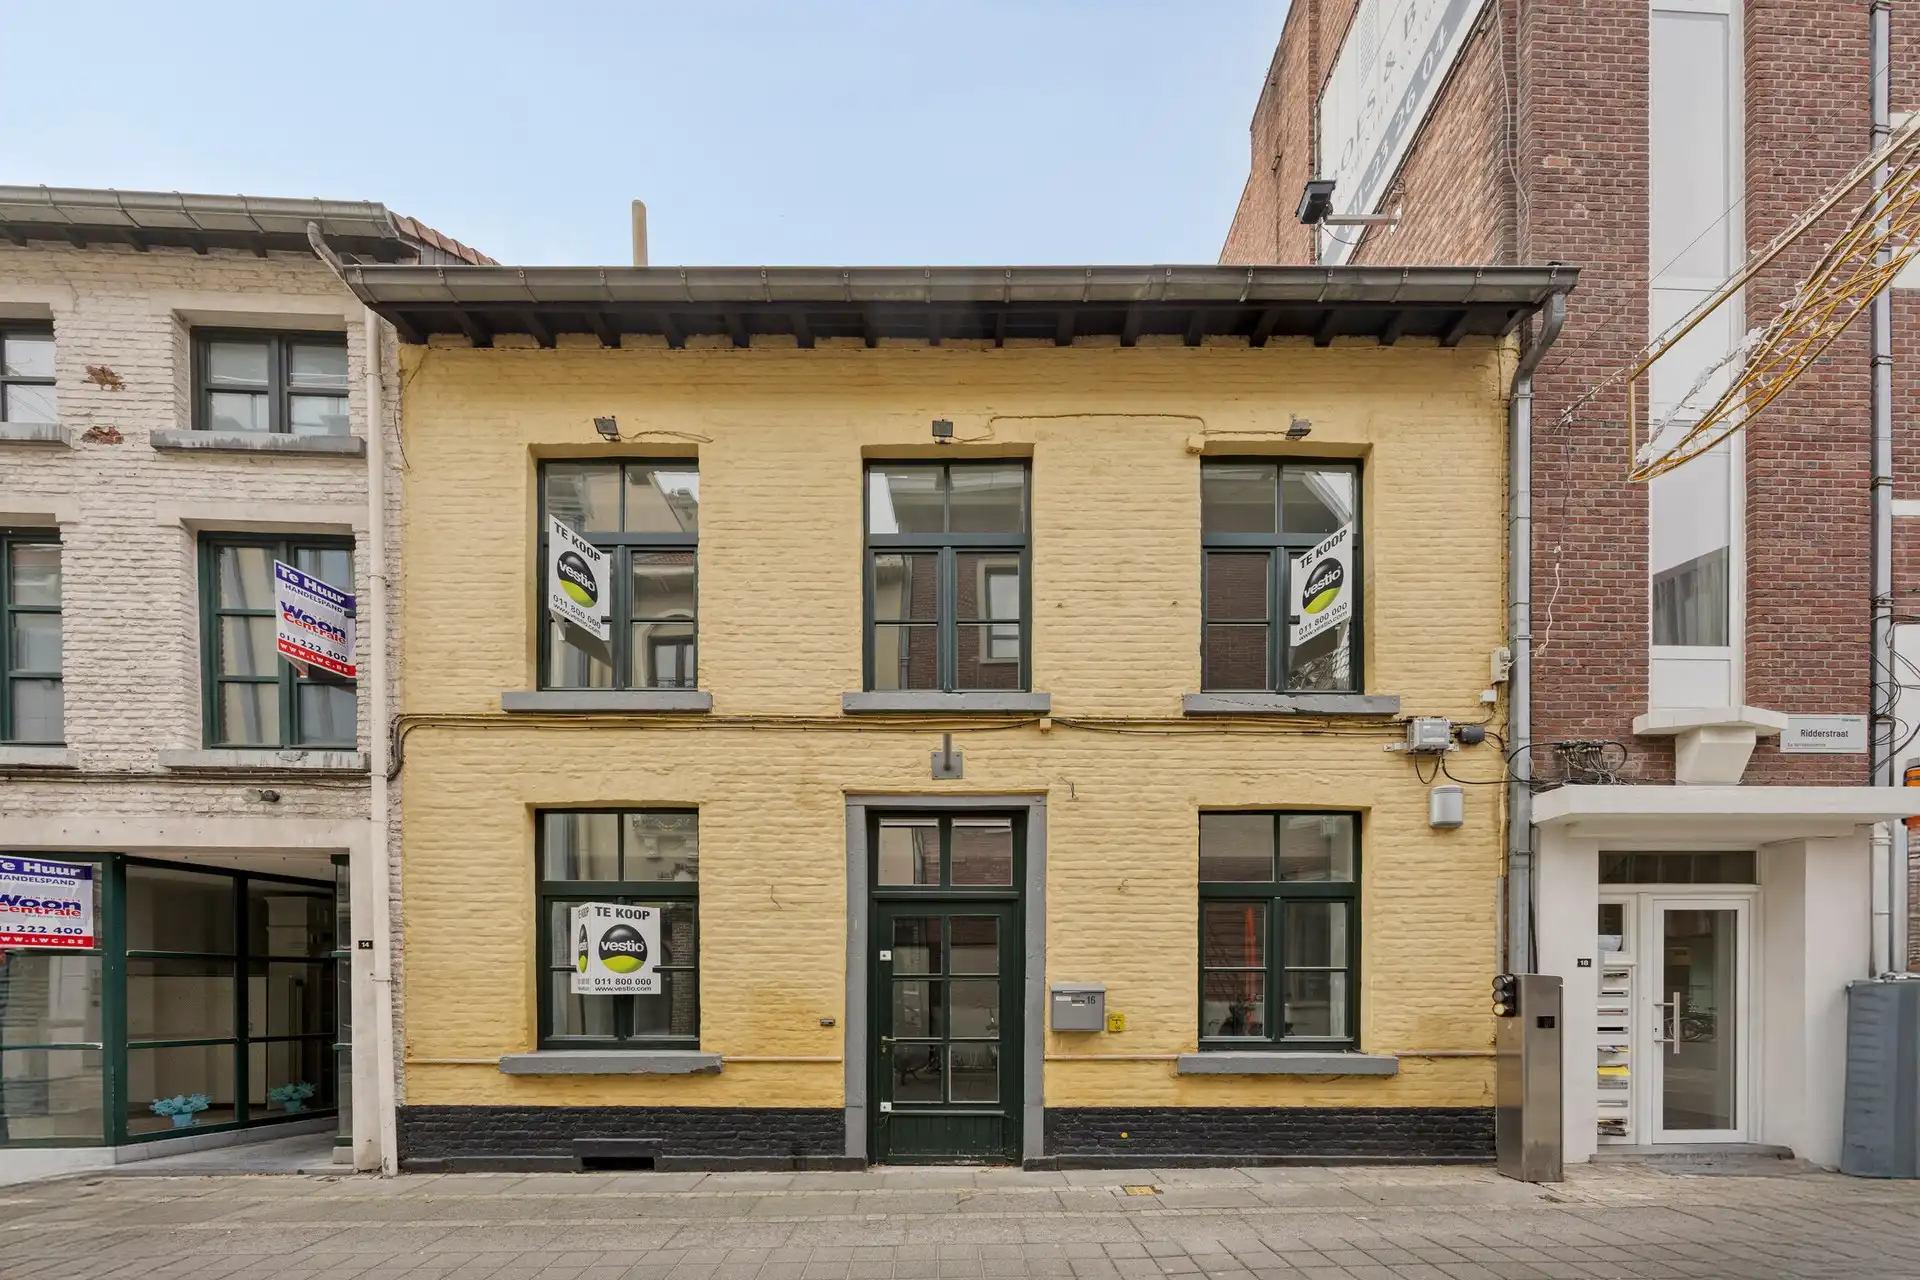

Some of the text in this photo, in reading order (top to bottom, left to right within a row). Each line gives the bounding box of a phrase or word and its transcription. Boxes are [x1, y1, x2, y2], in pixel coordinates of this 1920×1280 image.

[554, 521, 601, 562] TE KOOP
[1300, 529, 1347, 569] TE KOOP
[278, 565, 345, 603] Te Huur
[558, 560, 596, 592] vestio
[1304, 569, 1341, 599] vestio
[285, 583, 343, 613] HANDELSPAND
[553, 594, 568, 609] 011
[280, 600, 346, 639] Woon
[283, 613, 347, 645] Centrale
[1298, 602, 1348, 635] 011 800 000
[279, 632, 296, 643] 011
[301, 640, 322, 654] 222
[326, 650, 348, 663] 400
[1800, 729, 1849, 738] Ridderstraat
[0, 860, 81, 876] e Huur
[0, 875, 76, 886] ANDELSPAND
[595, 906, 611, 918] TE
[615, 908, 651, 920] KOOP
[17, 925, 48, 934] 222
[53, 927, 83, 935] 400
[601, 940, 645, 953] vestio
[595, 978, 612, 986] 011
[615, 978, 632, 986] 800
[635, 978, 652, 986] 000
